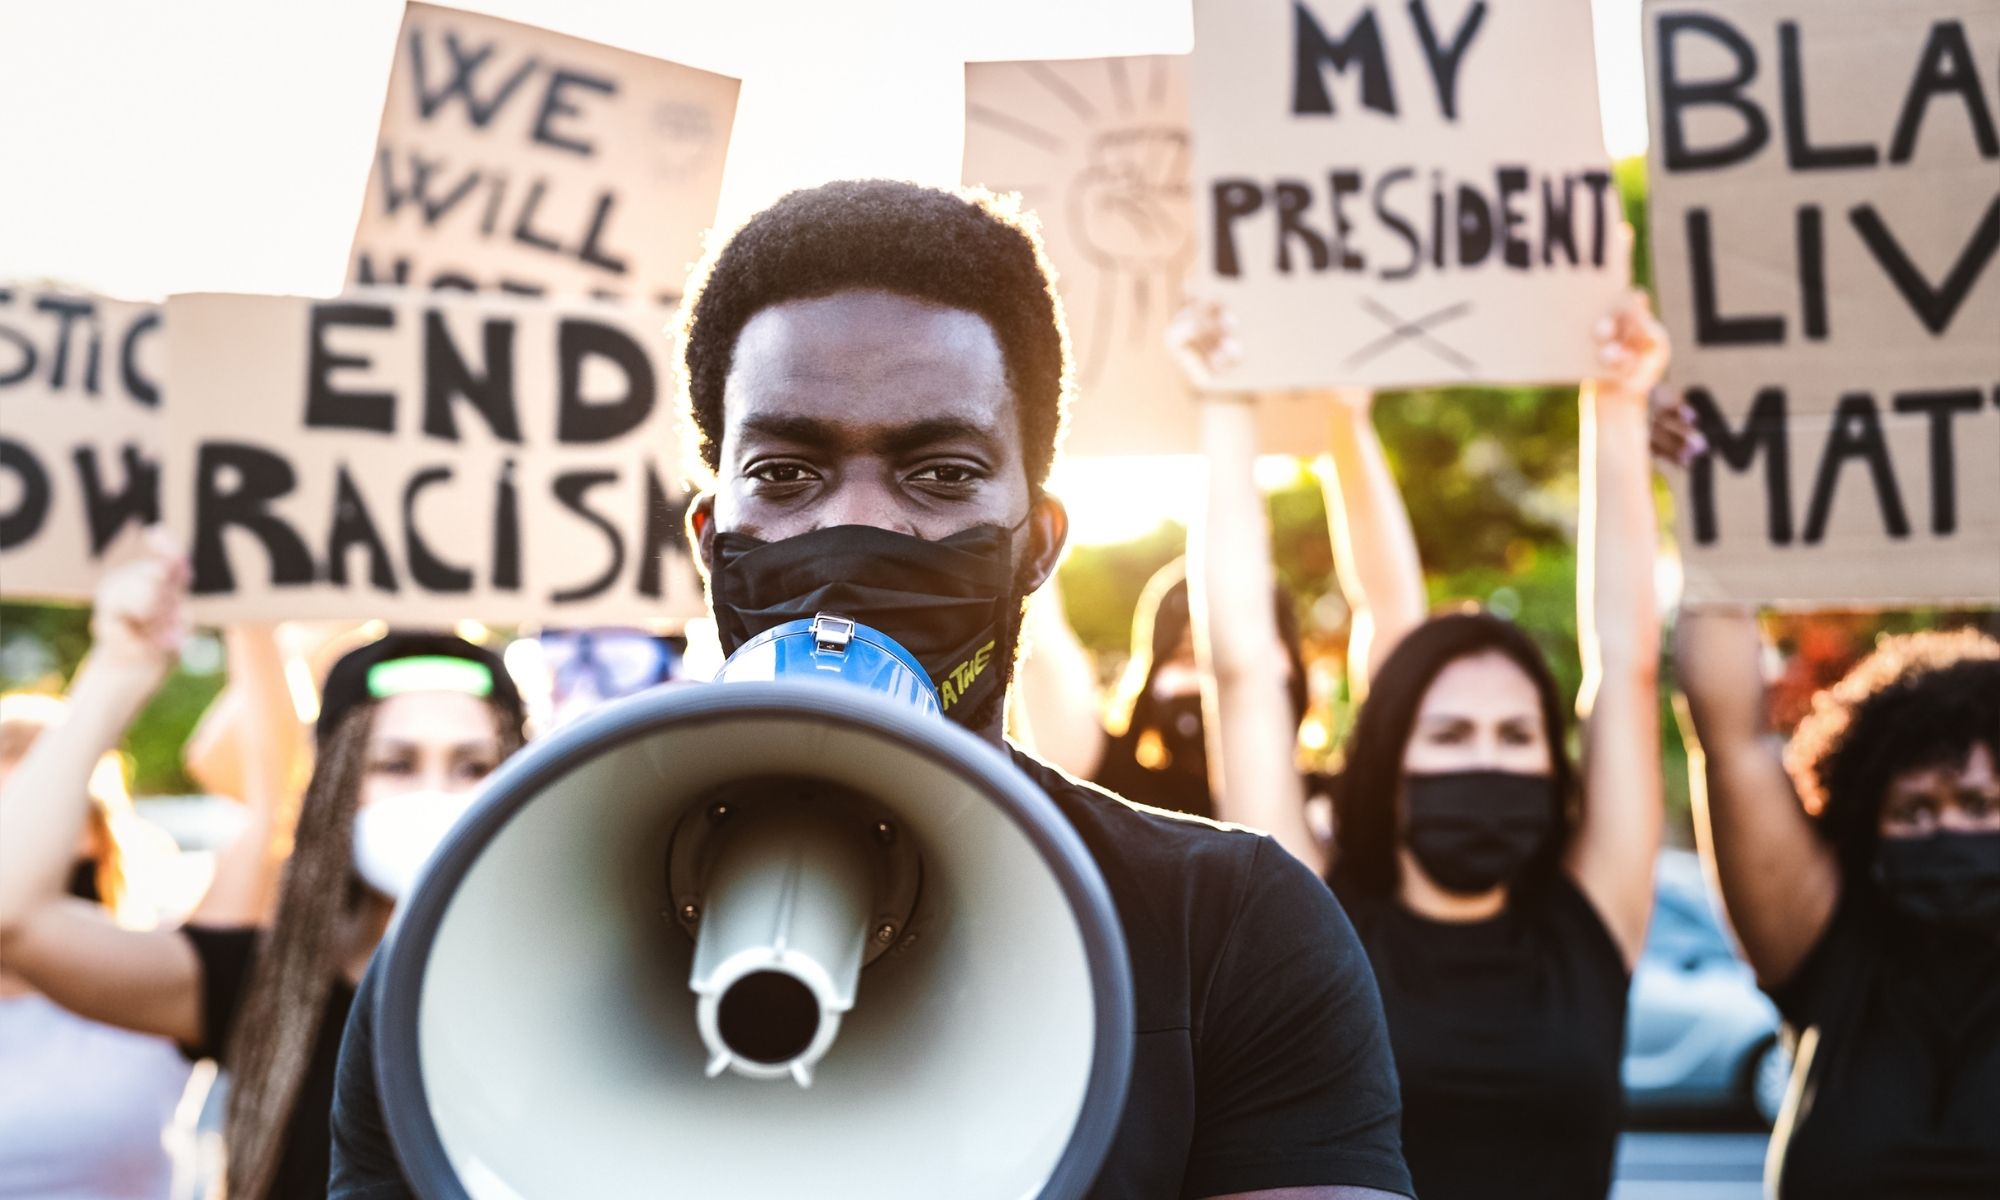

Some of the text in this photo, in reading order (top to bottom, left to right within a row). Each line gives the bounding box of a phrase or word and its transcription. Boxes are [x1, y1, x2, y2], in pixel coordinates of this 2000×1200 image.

[406, 24, 620, 157] WE
[1289, 0, 1490, 121] MY
[1656, 12, 2000, 171] BLA
[302, 300, 657, 446] END
[1686, 386, 2000, 546] MAT
[936, 639, 996, 711] ATHE
